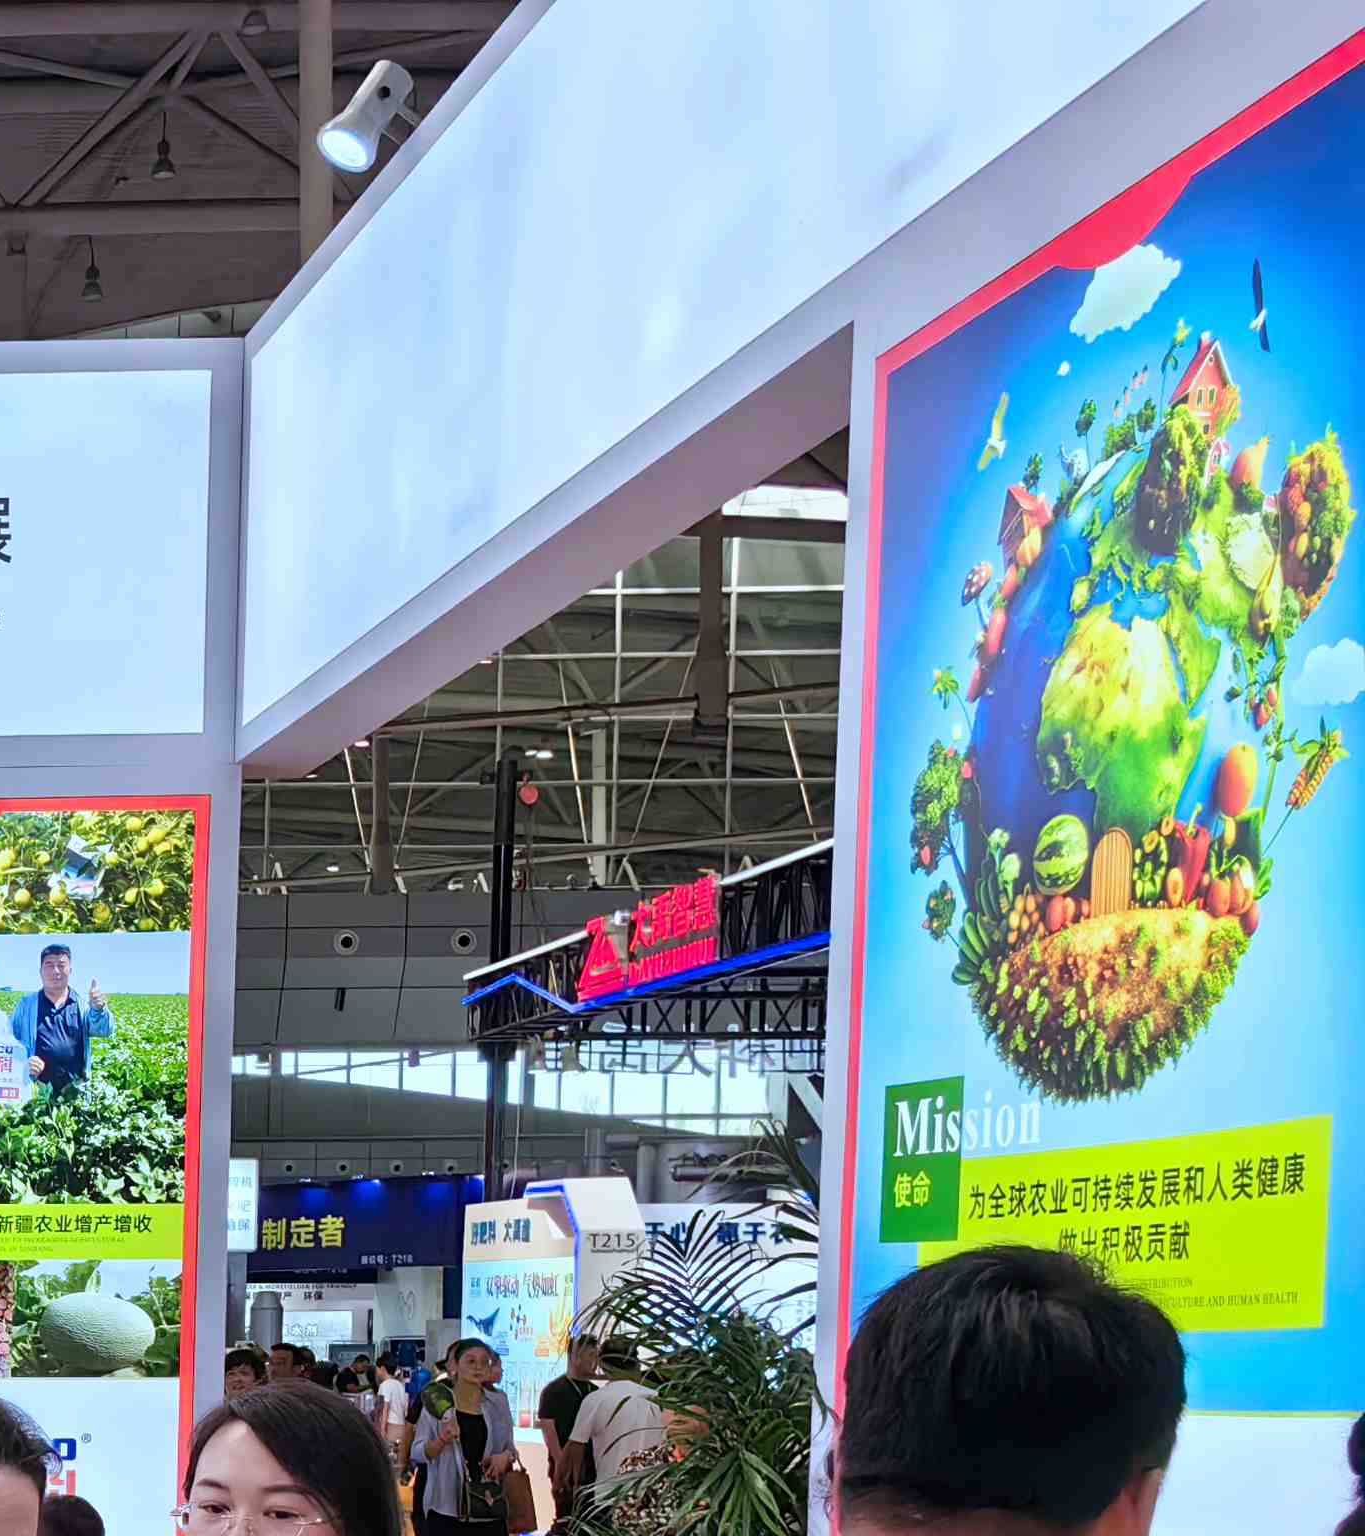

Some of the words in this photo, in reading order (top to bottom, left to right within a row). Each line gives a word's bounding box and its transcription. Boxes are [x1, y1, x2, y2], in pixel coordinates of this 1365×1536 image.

[893, 1090, 1040, 1158] Mission
[894, 1171, 931, 1209] 使命
[967, 1151, 1307, 1221] 为全球农业可持续发展和人类健康
[590, 1232, 637, 1249] T215
